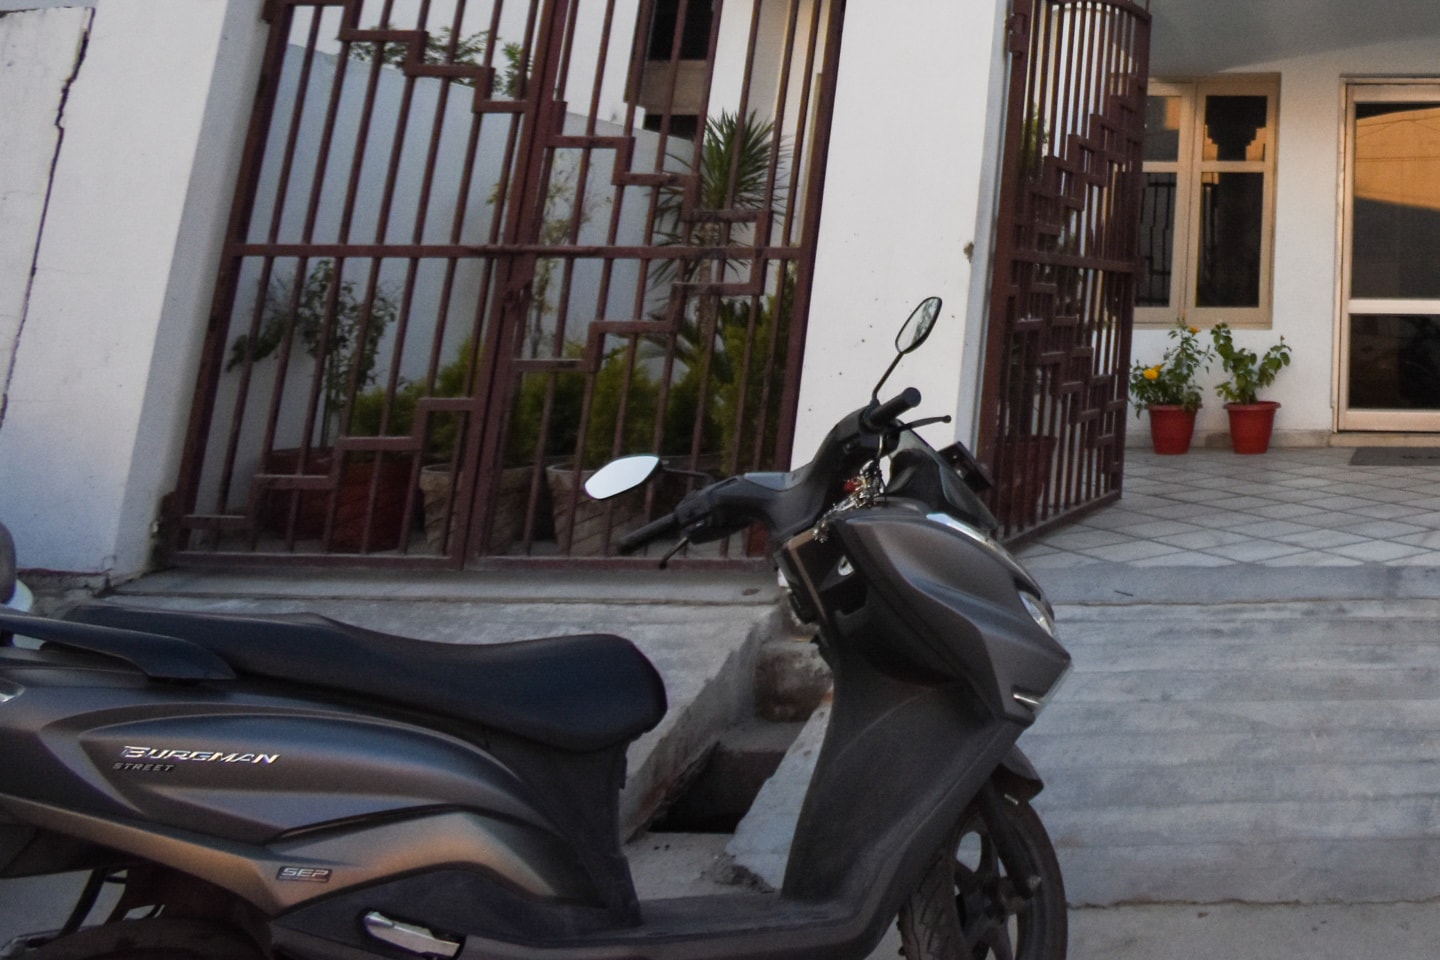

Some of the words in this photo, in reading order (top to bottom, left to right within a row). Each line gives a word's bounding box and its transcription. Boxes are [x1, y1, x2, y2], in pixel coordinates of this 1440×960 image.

[121, 745, 281, 764] BURGMAN
[112, 761, 174, 772] STREET
[281, 866, 330, 878] SEP
